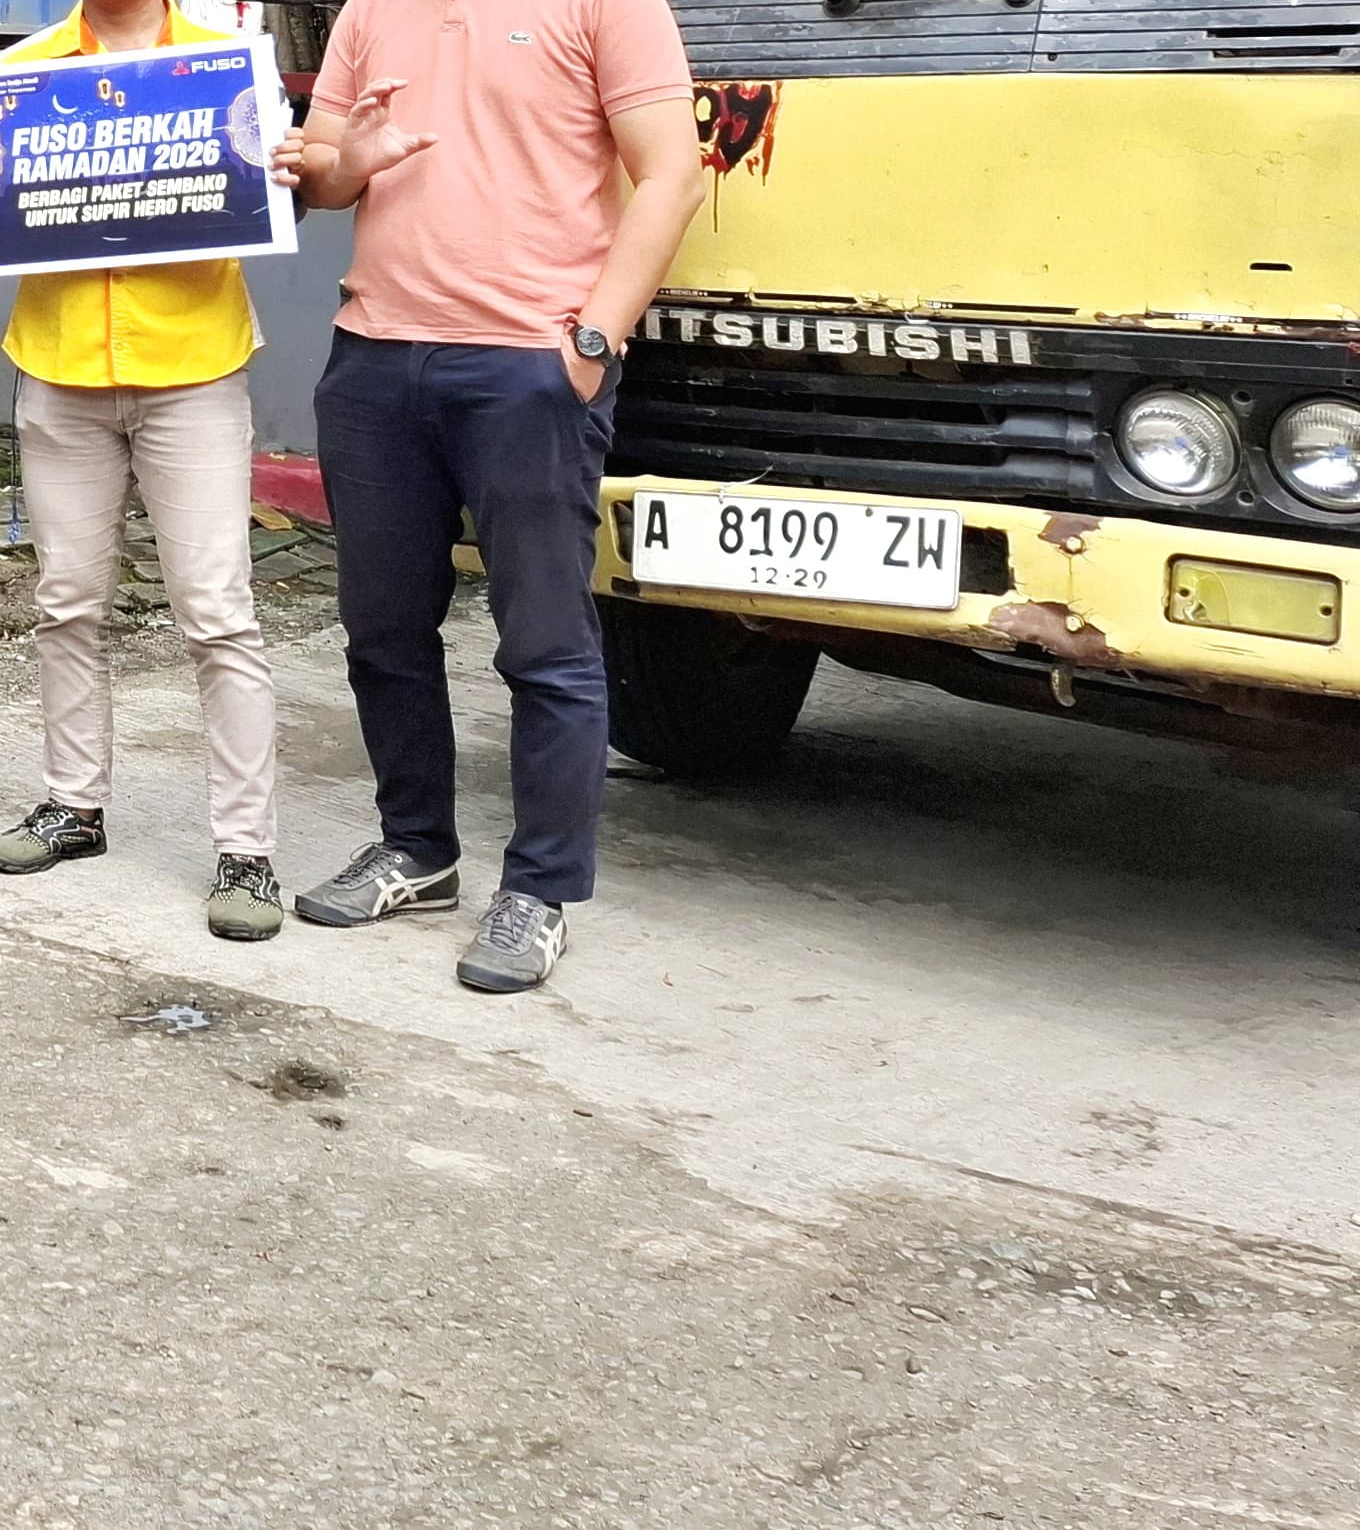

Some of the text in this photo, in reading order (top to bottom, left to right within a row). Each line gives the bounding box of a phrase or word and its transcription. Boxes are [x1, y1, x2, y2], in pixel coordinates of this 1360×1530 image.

[190, 57, 247, 74] FUSO
[11, 108, 215, 157] FUSO BERKAH
[12, 139, 221, 184] RAMADAN 2026
[18, 173, 227, 209] BERBAGI PAKET SEMBAKO
[25, 193, 224, 227] UNTUK SUPIR HERO FUSO
[645, 308, 1032, 365] ITSUBISHI
[645, 500, 946, 570] A 8199 ZW
